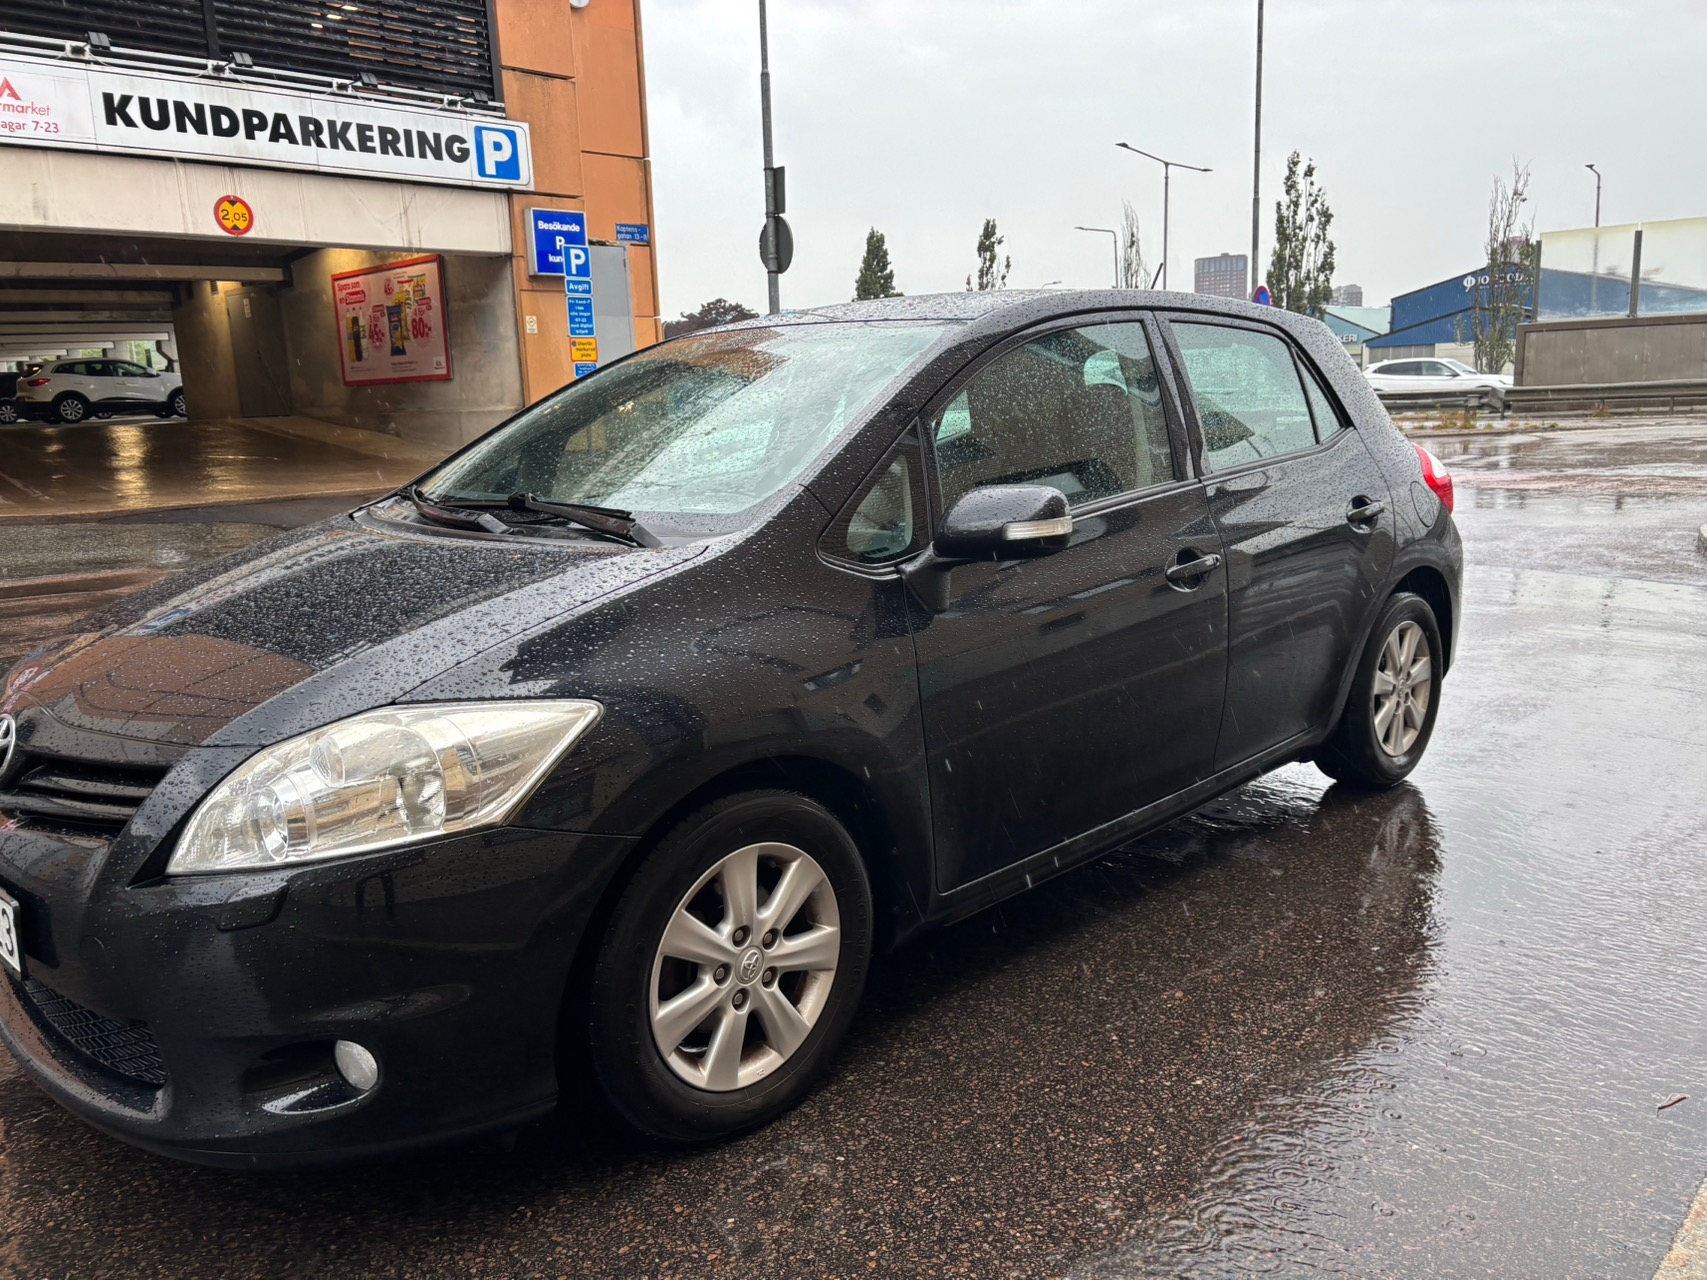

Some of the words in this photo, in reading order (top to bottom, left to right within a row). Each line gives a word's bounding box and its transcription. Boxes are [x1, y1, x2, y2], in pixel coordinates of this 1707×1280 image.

[0, 120, 27, 132] agar
[31, 120, 60, 133] 7-23
[102, 92, 471, 163] KUNDPARKERING
[481, 129, 512, 176] P
[220, 208, 248, 223] 2,05
[537, 220, 581, 232] Besökande
[555, 236, 565, 250] P
[548, 254, 563, 263] kun
[569, 248, 586, 275] P
[569, 282, 590, 292] Avgift
[1335, 334, 1358, 342] KERI
[0, 907, 14, 958] 3
